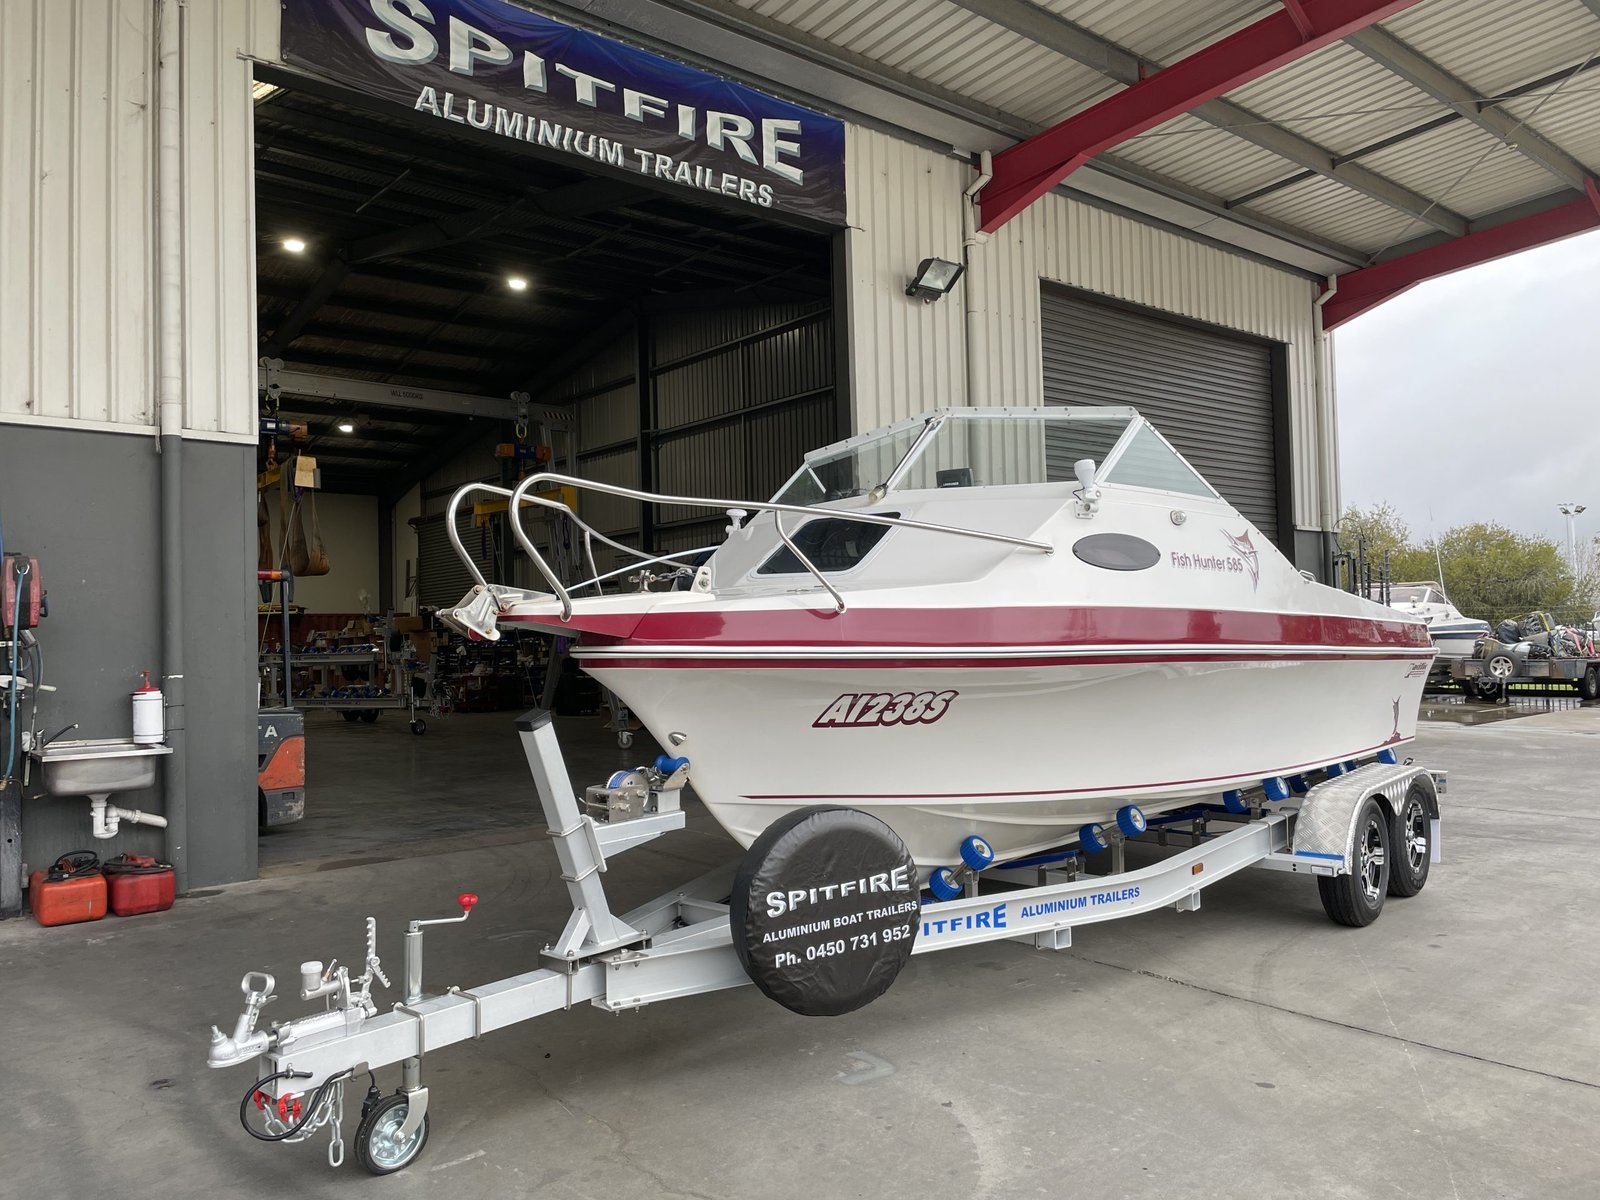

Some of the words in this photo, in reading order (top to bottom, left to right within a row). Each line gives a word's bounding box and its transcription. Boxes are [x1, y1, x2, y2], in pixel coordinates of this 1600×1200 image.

[365, 0, 804, 185] SPITFIRE
[414, 86, 624, 168] ALUMINIUM
[634, 148, 774, 208] TRAILERS
[1171, 552, 1192, 568] Fish
[1193, 554, 1226, 571] Hunter
[1226, 557, 1243, 573] 585
[765, 864, 910, 919] SPITFIRE
[923, 903, 1007, 937] ITFIRE
[1021, 896, 1087, 918] ALUMINIUM
[1090, 887, 1140, 906] TRAILERS
[763, 919, 831, 943] ALUMINIUM
[833, 912, 864, 928] BOAT
[866, 900, 918, 920] TRAILERS
[775, 952, 802, 969] Ph.
[806, 940, 846, 961] 0450
[850, 931, 878, 951] 731
[882, 924, 911, 944] 952
